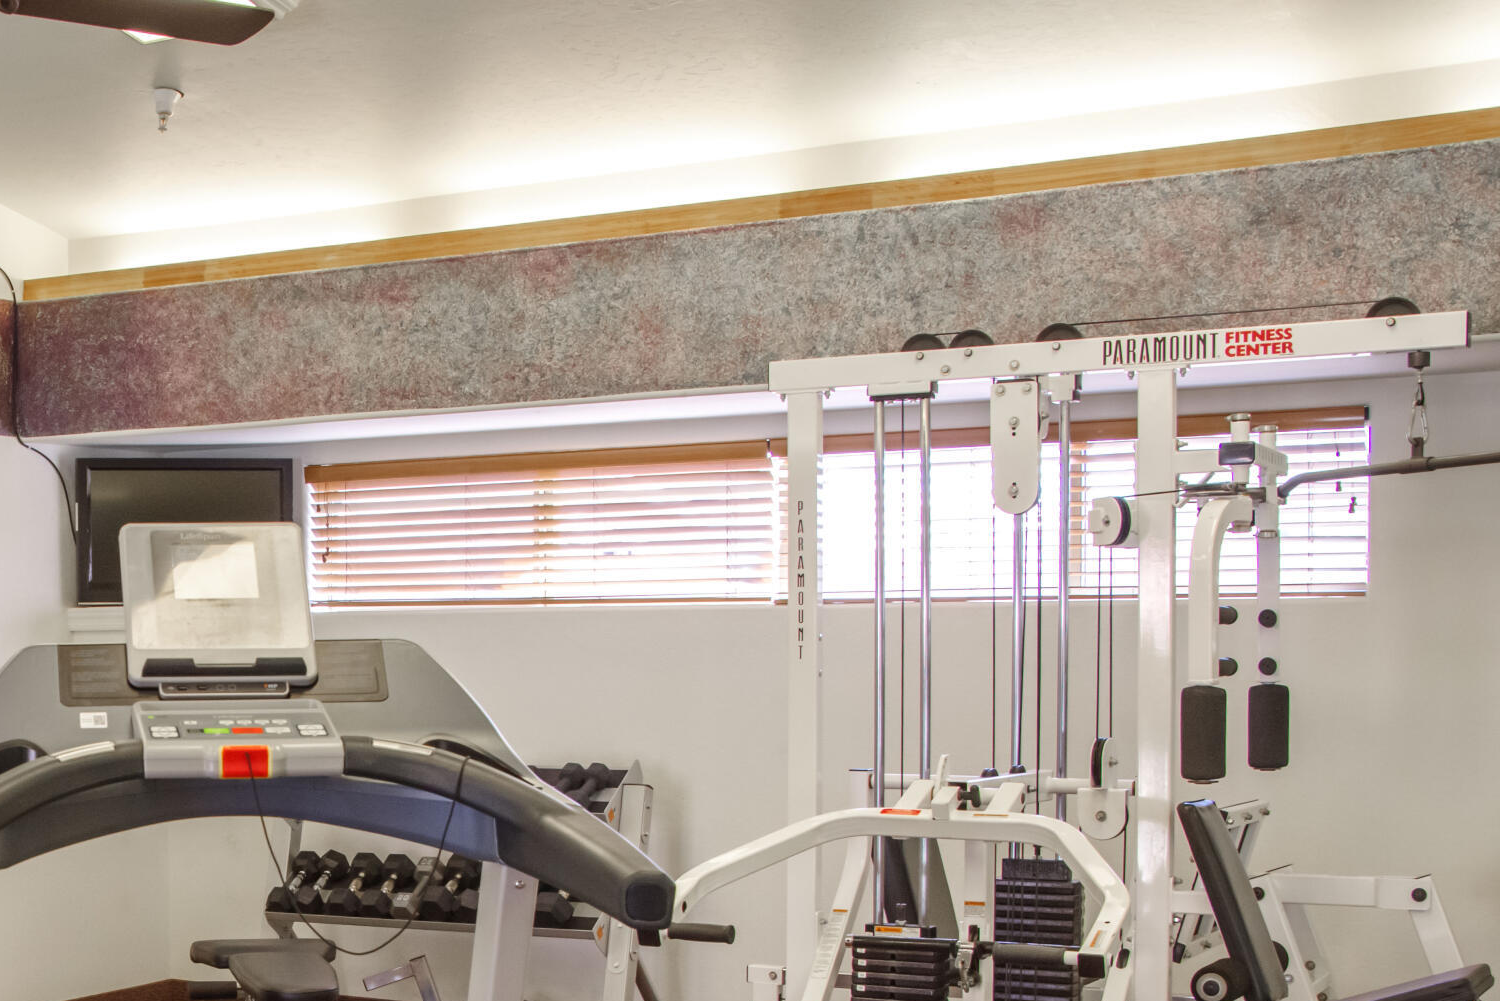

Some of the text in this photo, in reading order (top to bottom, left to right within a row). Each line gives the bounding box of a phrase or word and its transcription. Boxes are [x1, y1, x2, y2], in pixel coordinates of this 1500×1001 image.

[1225, 327, 1292, 344] FITNESS
[1103, 333, 1219, 366] PARAMOUNT
[1224, 341, 1294, 358] CENTER
[797, 500, 805, 660] PARAMOUNT
